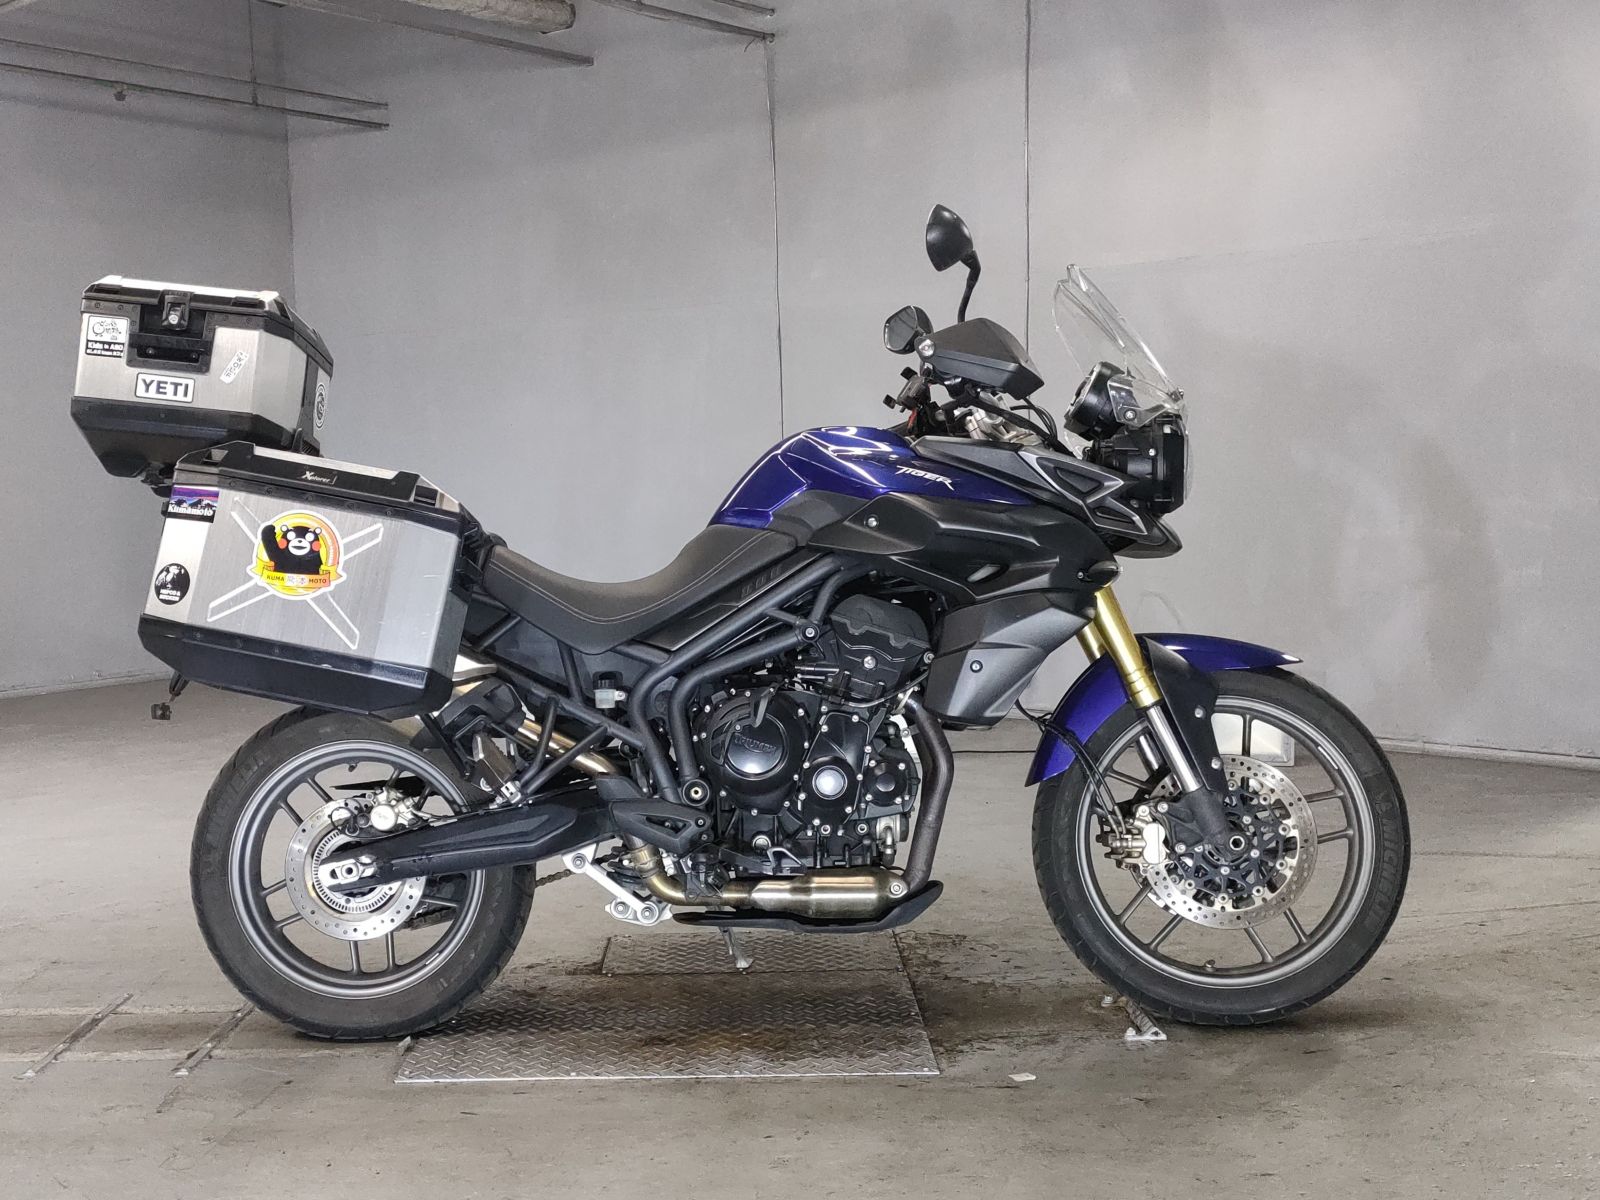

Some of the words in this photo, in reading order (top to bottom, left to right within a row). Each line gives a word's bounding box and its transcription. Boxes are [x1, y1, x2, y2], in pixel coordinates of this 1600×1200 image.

[141, 378, 189, 398] YETI
[301, 471, 331, 482] Xplorer
[895, 465, 955, 491] TIGER
[167, 504, 214, 517] Kumamoto
